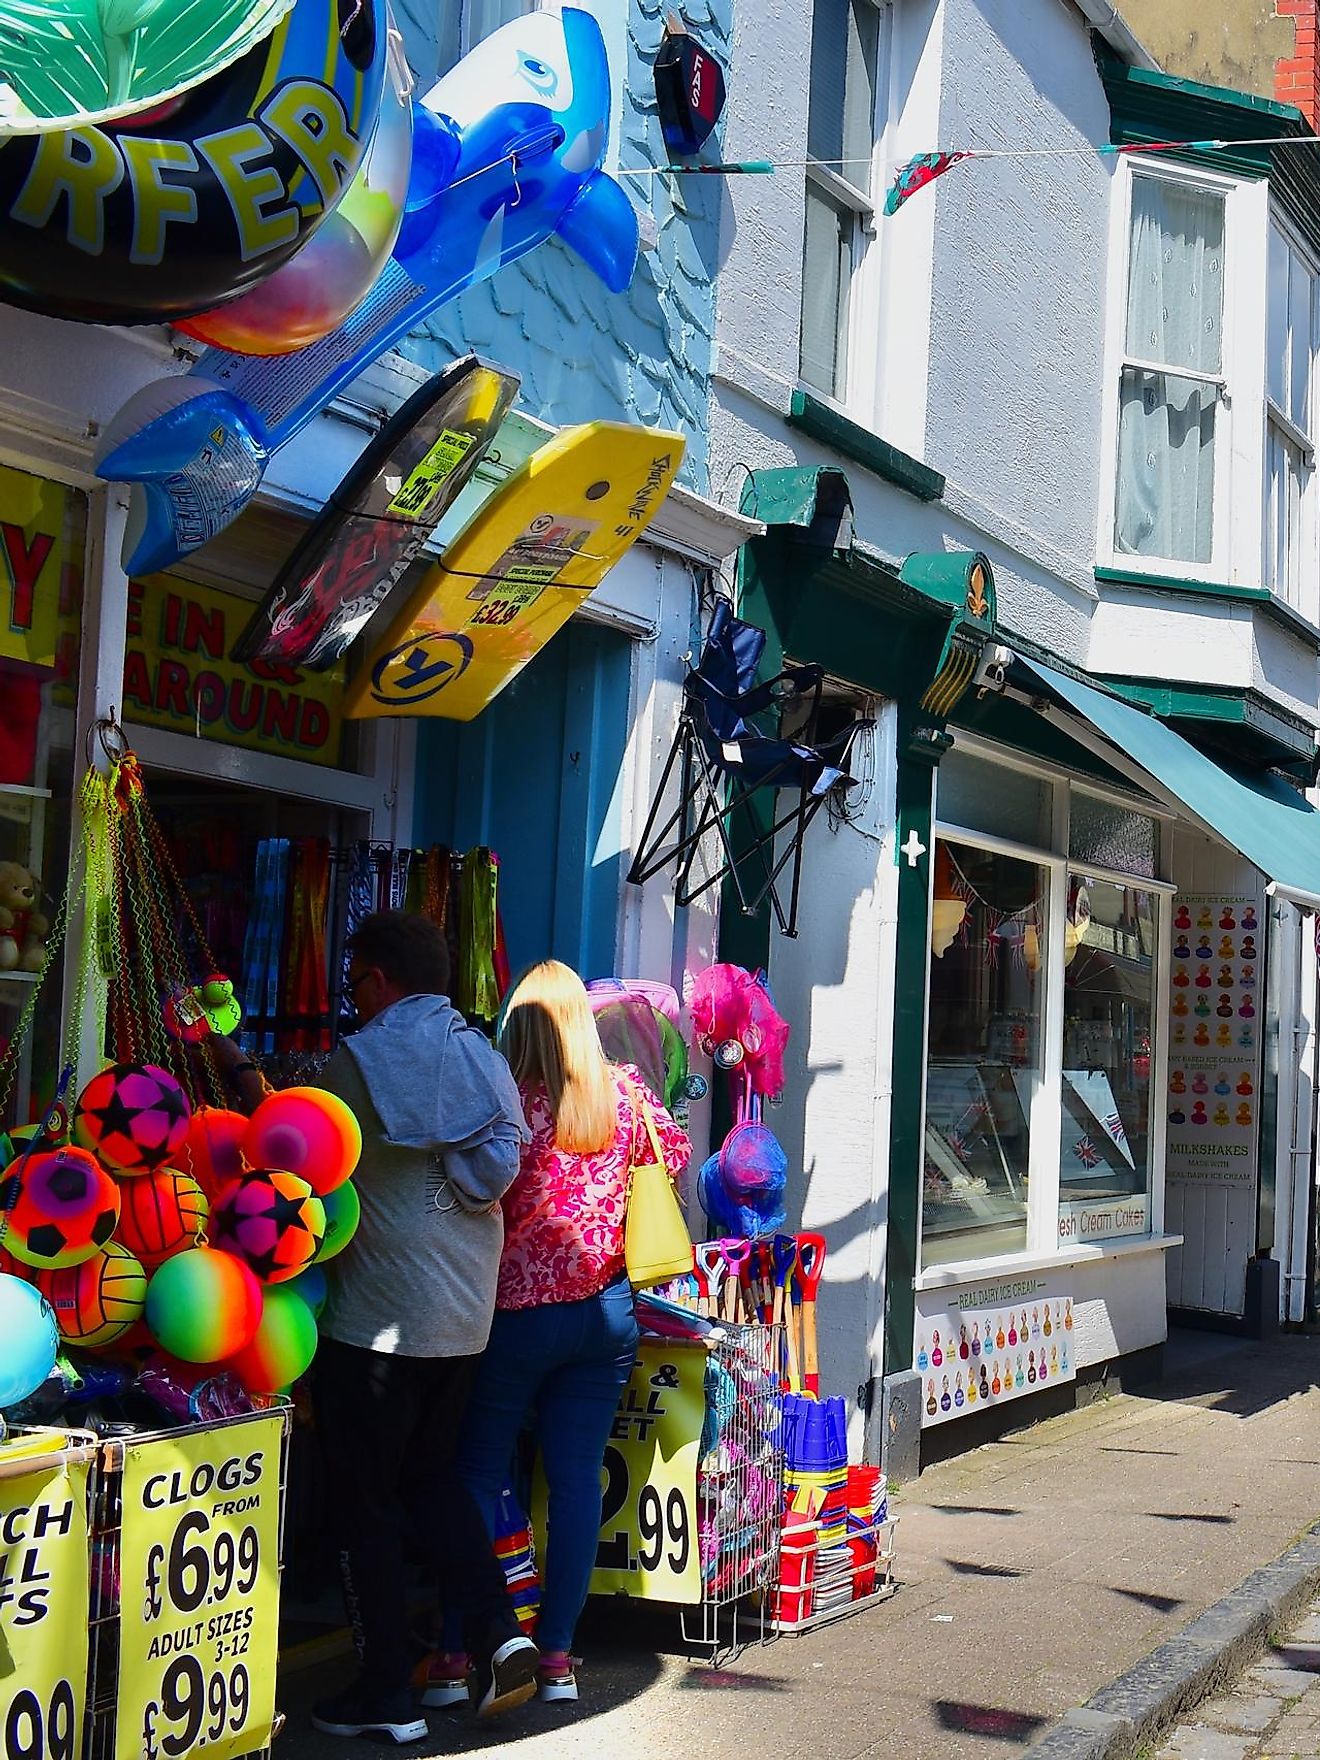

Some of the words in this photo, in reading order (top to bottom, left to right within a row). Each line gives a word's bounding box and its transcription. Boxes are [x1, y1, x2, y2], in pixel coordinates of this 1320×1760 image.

[162, 594, 226, 660] IN
[124, 652, 331, 750] AROUND
[1170, 1143, 1249, 1156] MILKSHAKES
[1080, 1211, 1112, 1233] Cream
[1115, 1206, 1145, 1228] Cakes
[960, 1291, 978, 1310] REAL
[979, 1287, 999, 1305] DAIRY
[1013, 1279, 1037, 1297] CREAM
[142, 1452, 264, 1509] CLOGS
[211, 1494, 261, 1518] FROM
[144, 1511, 260, 1623] £6.99
[146, 1622, 203, 1661] ADULT
[206, 1606, 254, 1641] SIZES
[214, 1632, 250, 1664] 3-12
[142, 1655, 250, 1760] £9.99
